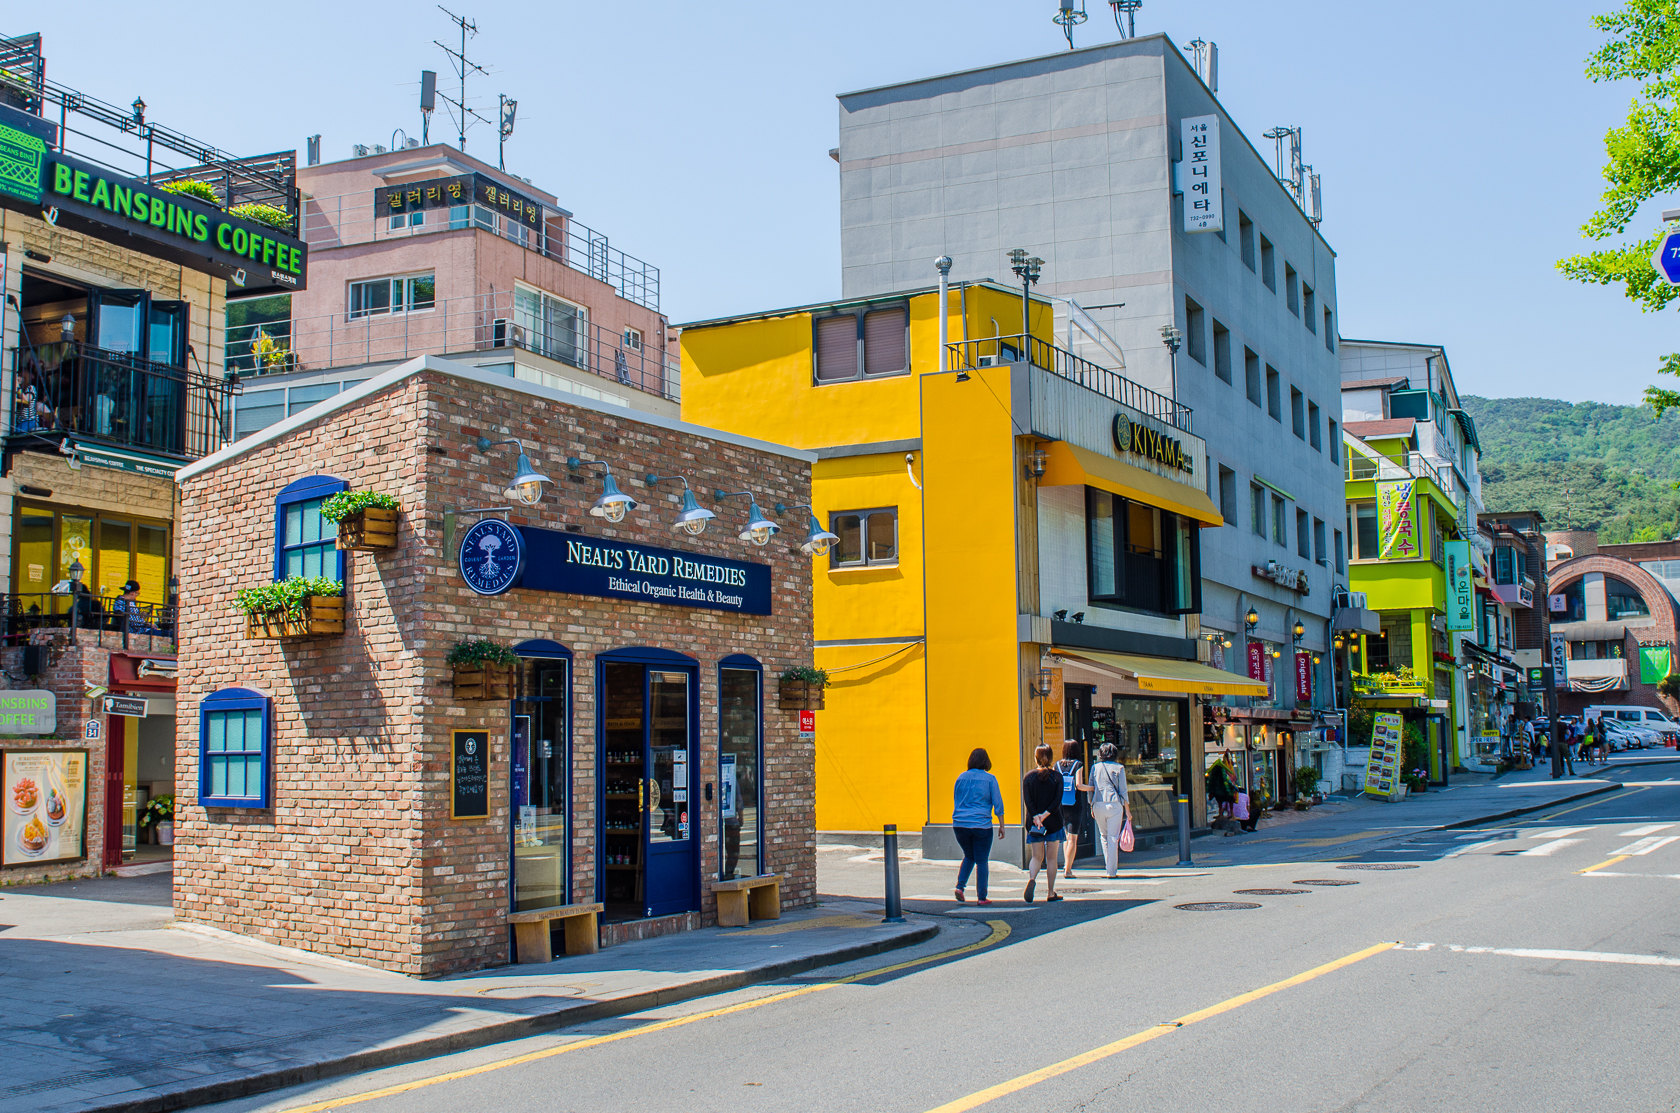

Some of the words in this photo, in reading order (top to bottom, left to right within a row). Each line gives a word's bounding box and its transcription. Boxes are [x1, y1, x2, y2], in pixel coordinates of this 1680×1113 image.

[1190, 123, 1208, 133] 서울
[1191, 134, 1211, 211] 신포니에타
[54, 162, 208, 242] BEANSBINS
[217, 222, 301, 274] COFFEE
[1396, 482, 1414, 555] 냉콩국수
[608, 576, 640, 593] Ethical
[642, 581, 677, 599] Organic
[678, 585, 706, 601] Health
[707, 592, 714, 602] &
[715, 591, 743, 608] Beauty
[626, 549, 669, 575] YARD
[672, 556, 746, 587] REMEDIES
